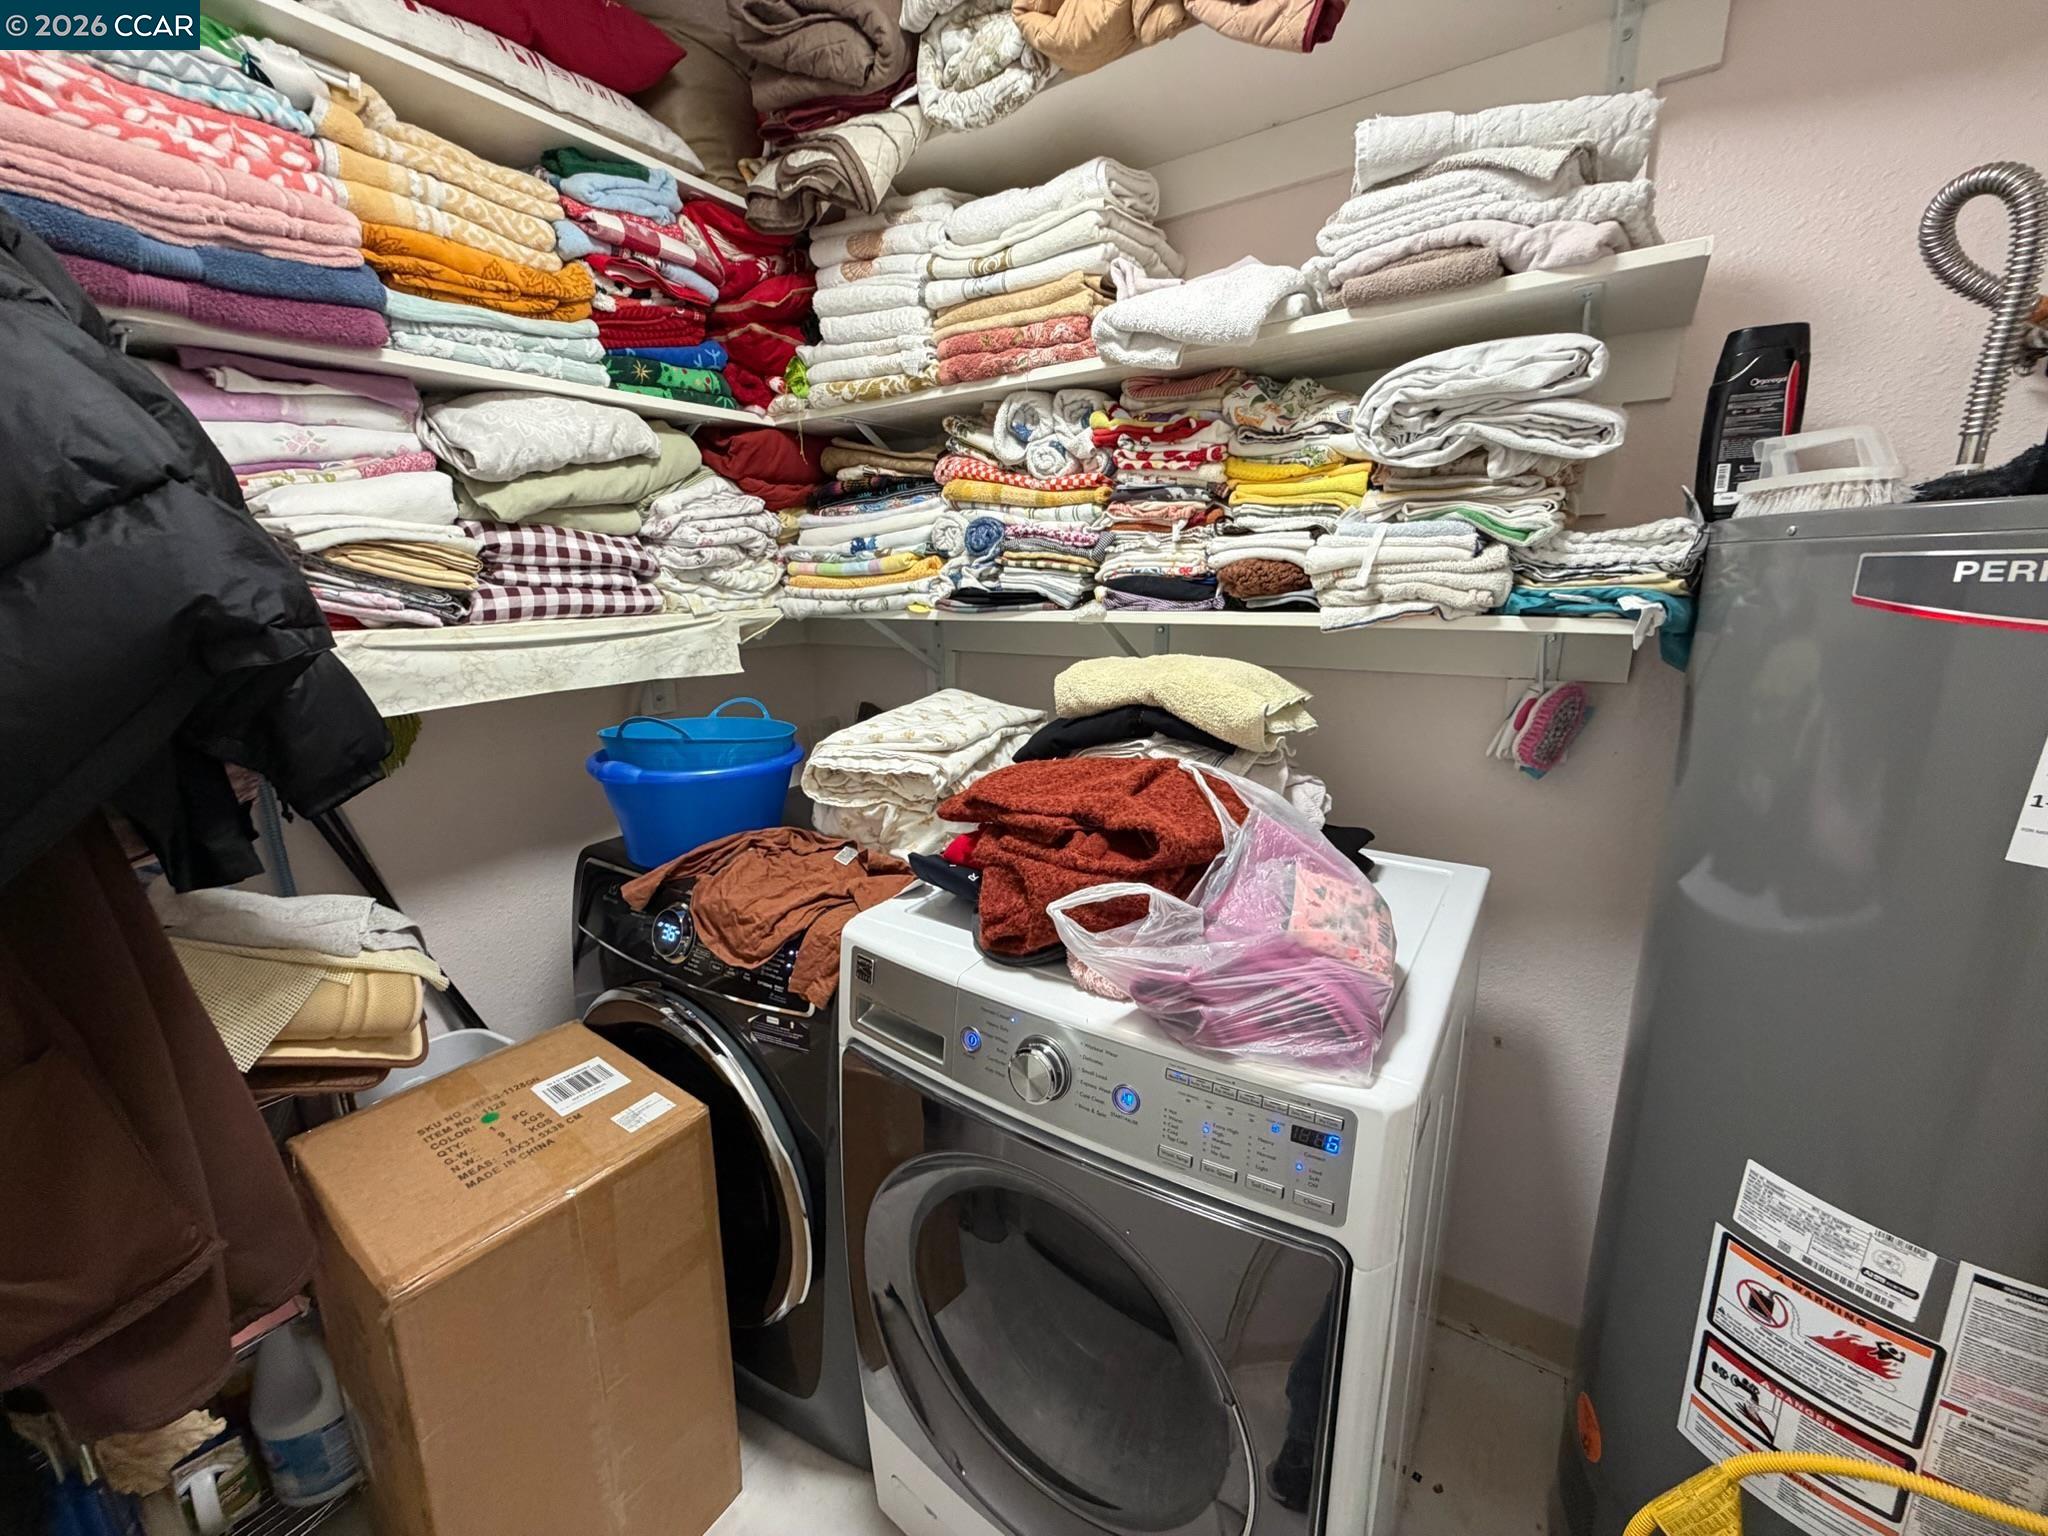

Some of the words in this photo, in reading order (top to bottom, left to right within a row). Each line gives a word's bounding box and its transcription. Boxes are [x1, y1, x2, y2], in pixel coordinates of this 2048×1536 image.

[416, 1119, 442, 1137] SKU
[521, 1111, 546, 1127] KGS
[528, 1118, 553, 1133] KGS
[422, 1126, 453, 1144] ITEM
[430, 1125, 478, 1151] COLOR:
[436, 1140, 467, 1158] QTY:
[511, 1109, 529, 1122] PC
[1326, 1135, 1340, 1152] 6
[457, 1157, 496, 1182] MEAS:
[566, 1112, 584, 1125] CM
[465, 1166, 501, 1190] MADE
[503, 1158, 517, 1169] IN
[518, 1138, 556, 1161] CHINA
[1791, 1282, 1867, 1327] WARNING
[1774, 1387, 1836, 1431] DANGER
